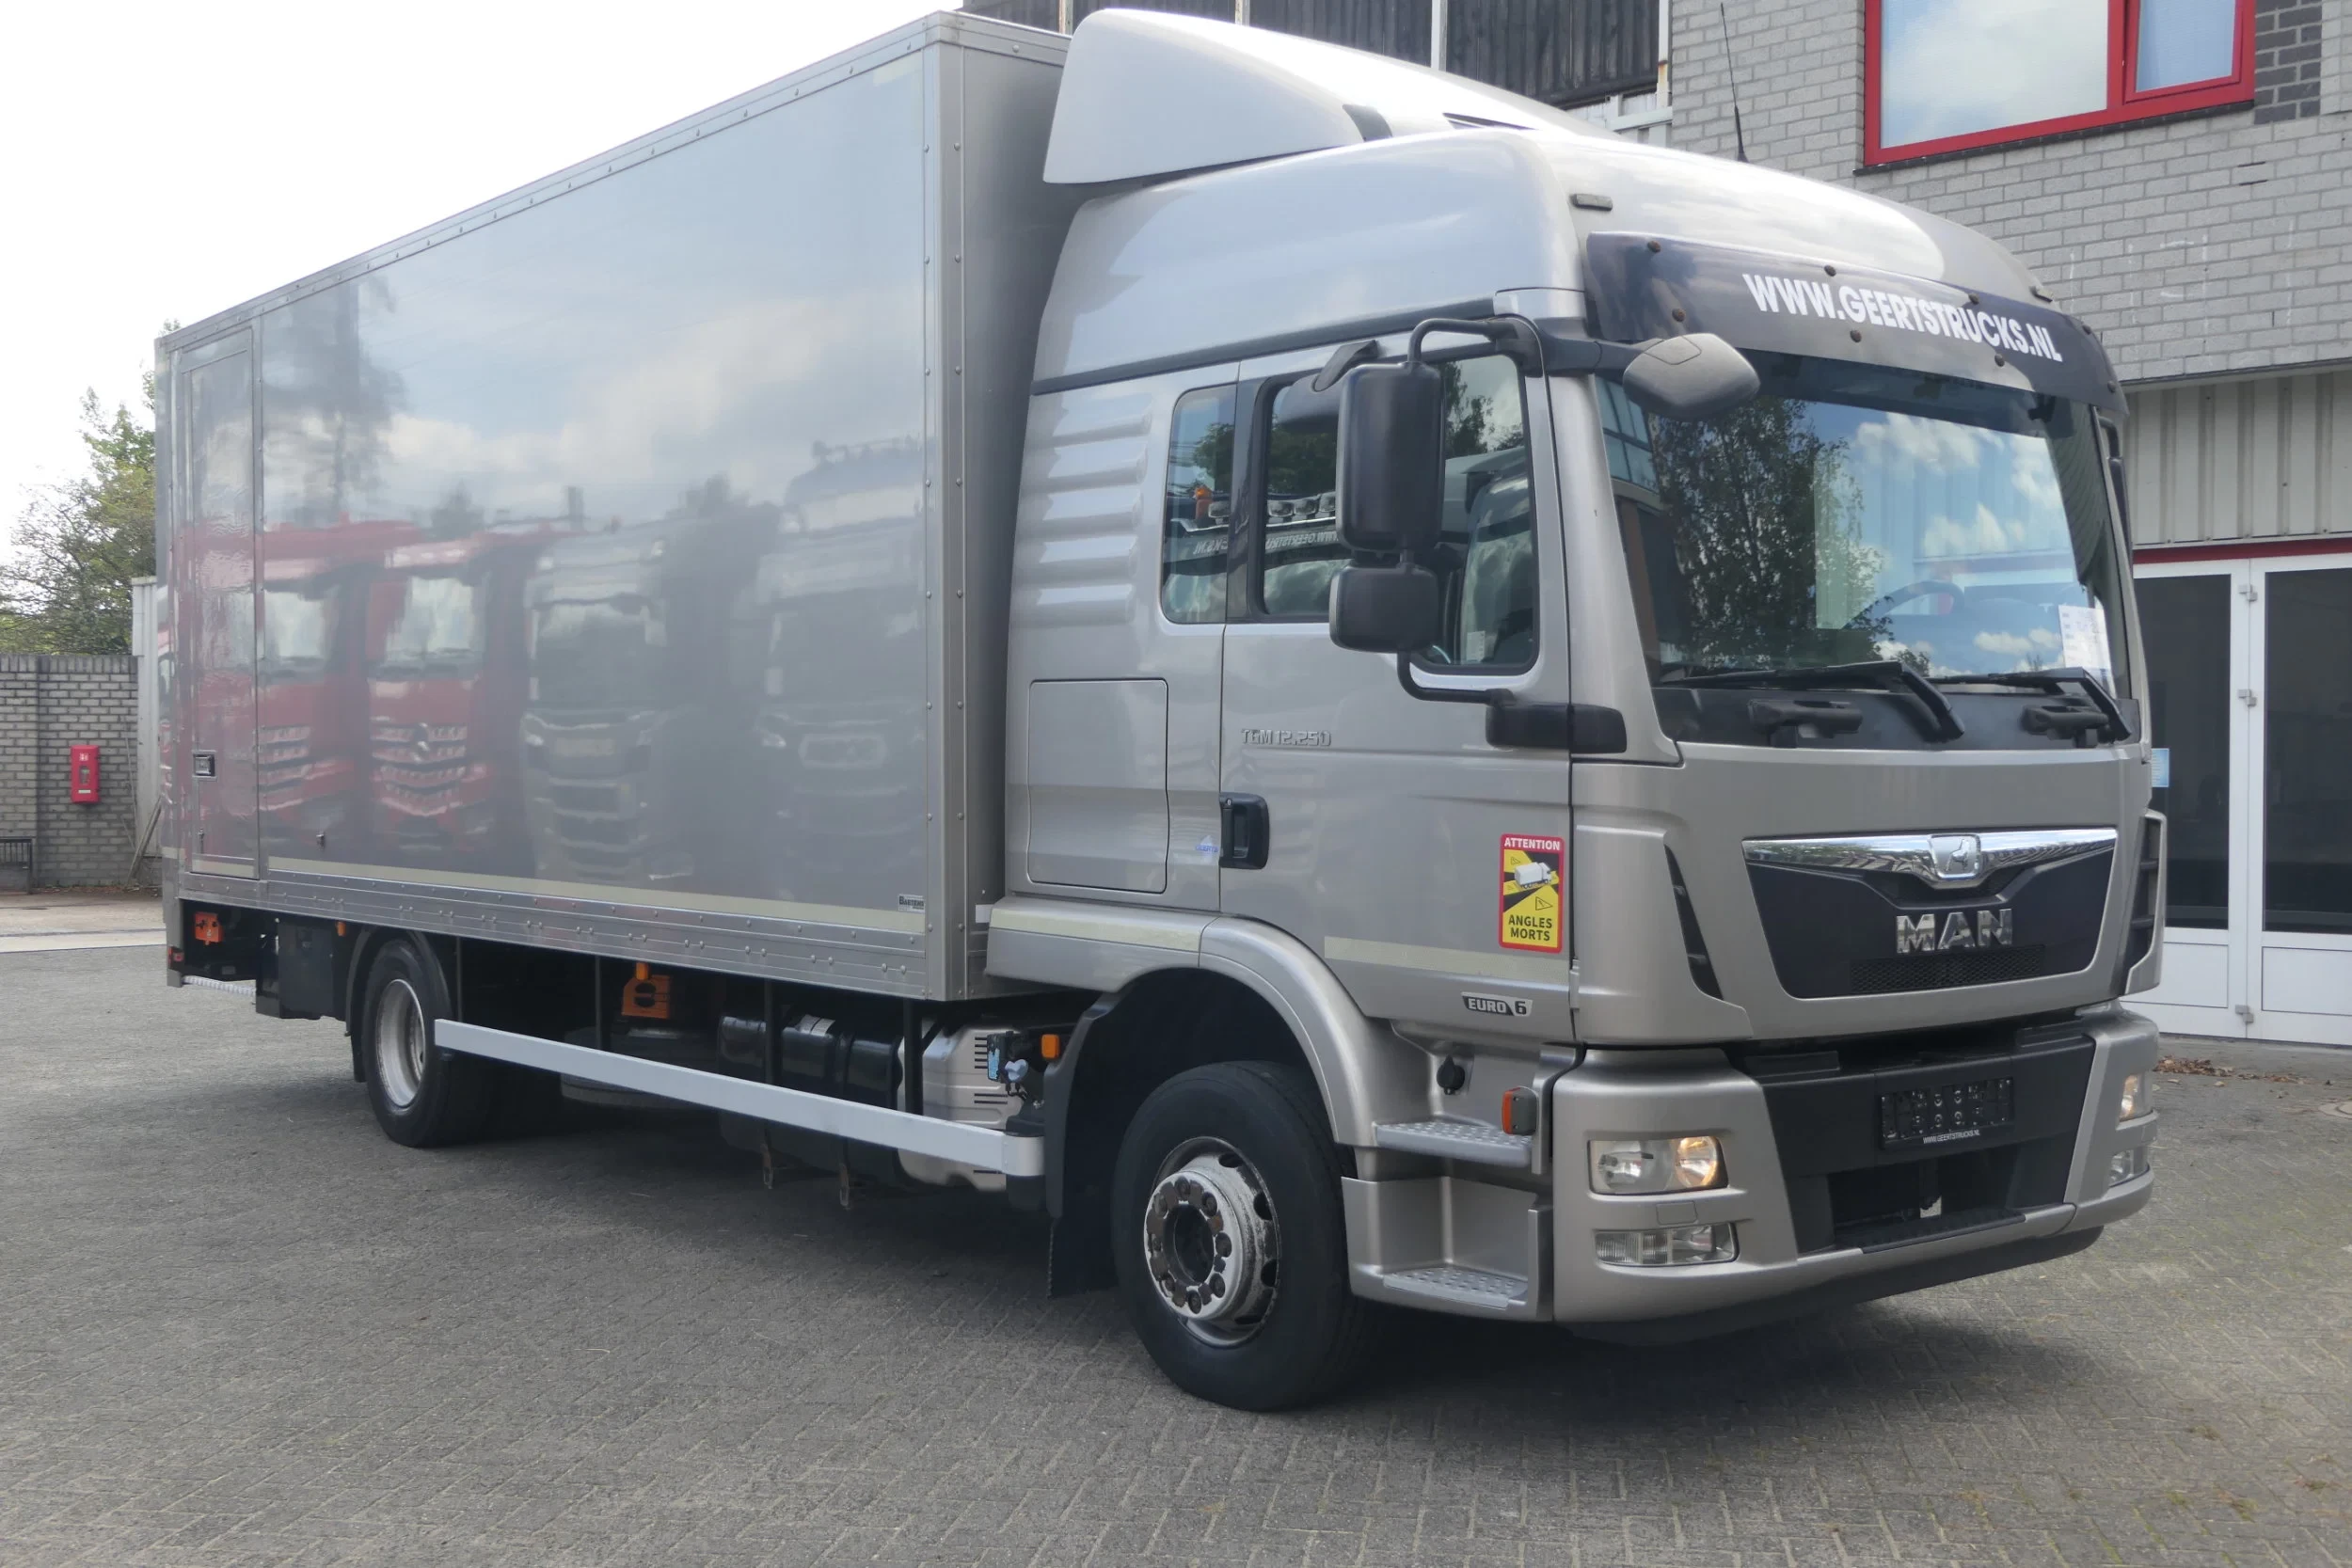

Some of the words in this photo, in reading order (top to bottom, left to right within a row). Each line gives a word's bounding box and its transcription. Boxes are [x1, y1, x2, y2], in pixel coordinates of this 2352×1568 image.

[1742, 273, 2062, 362] WWW.GEERTSTRUCKS.NL
[1242, 729, 1273, 745] TGM
[1276, 730, 1331, 747] 12.250
[1503, 837, 1561, 851] ATTENTION
[1508, 914, 1553, 929] ANGLES
[1510, 927, 1550, 942] MORTS
[1896, 908, 2012, 954] MAN
[1468, 998, 1507, 1013] EURO
[1515, 1000, 1527, 1015] 6
